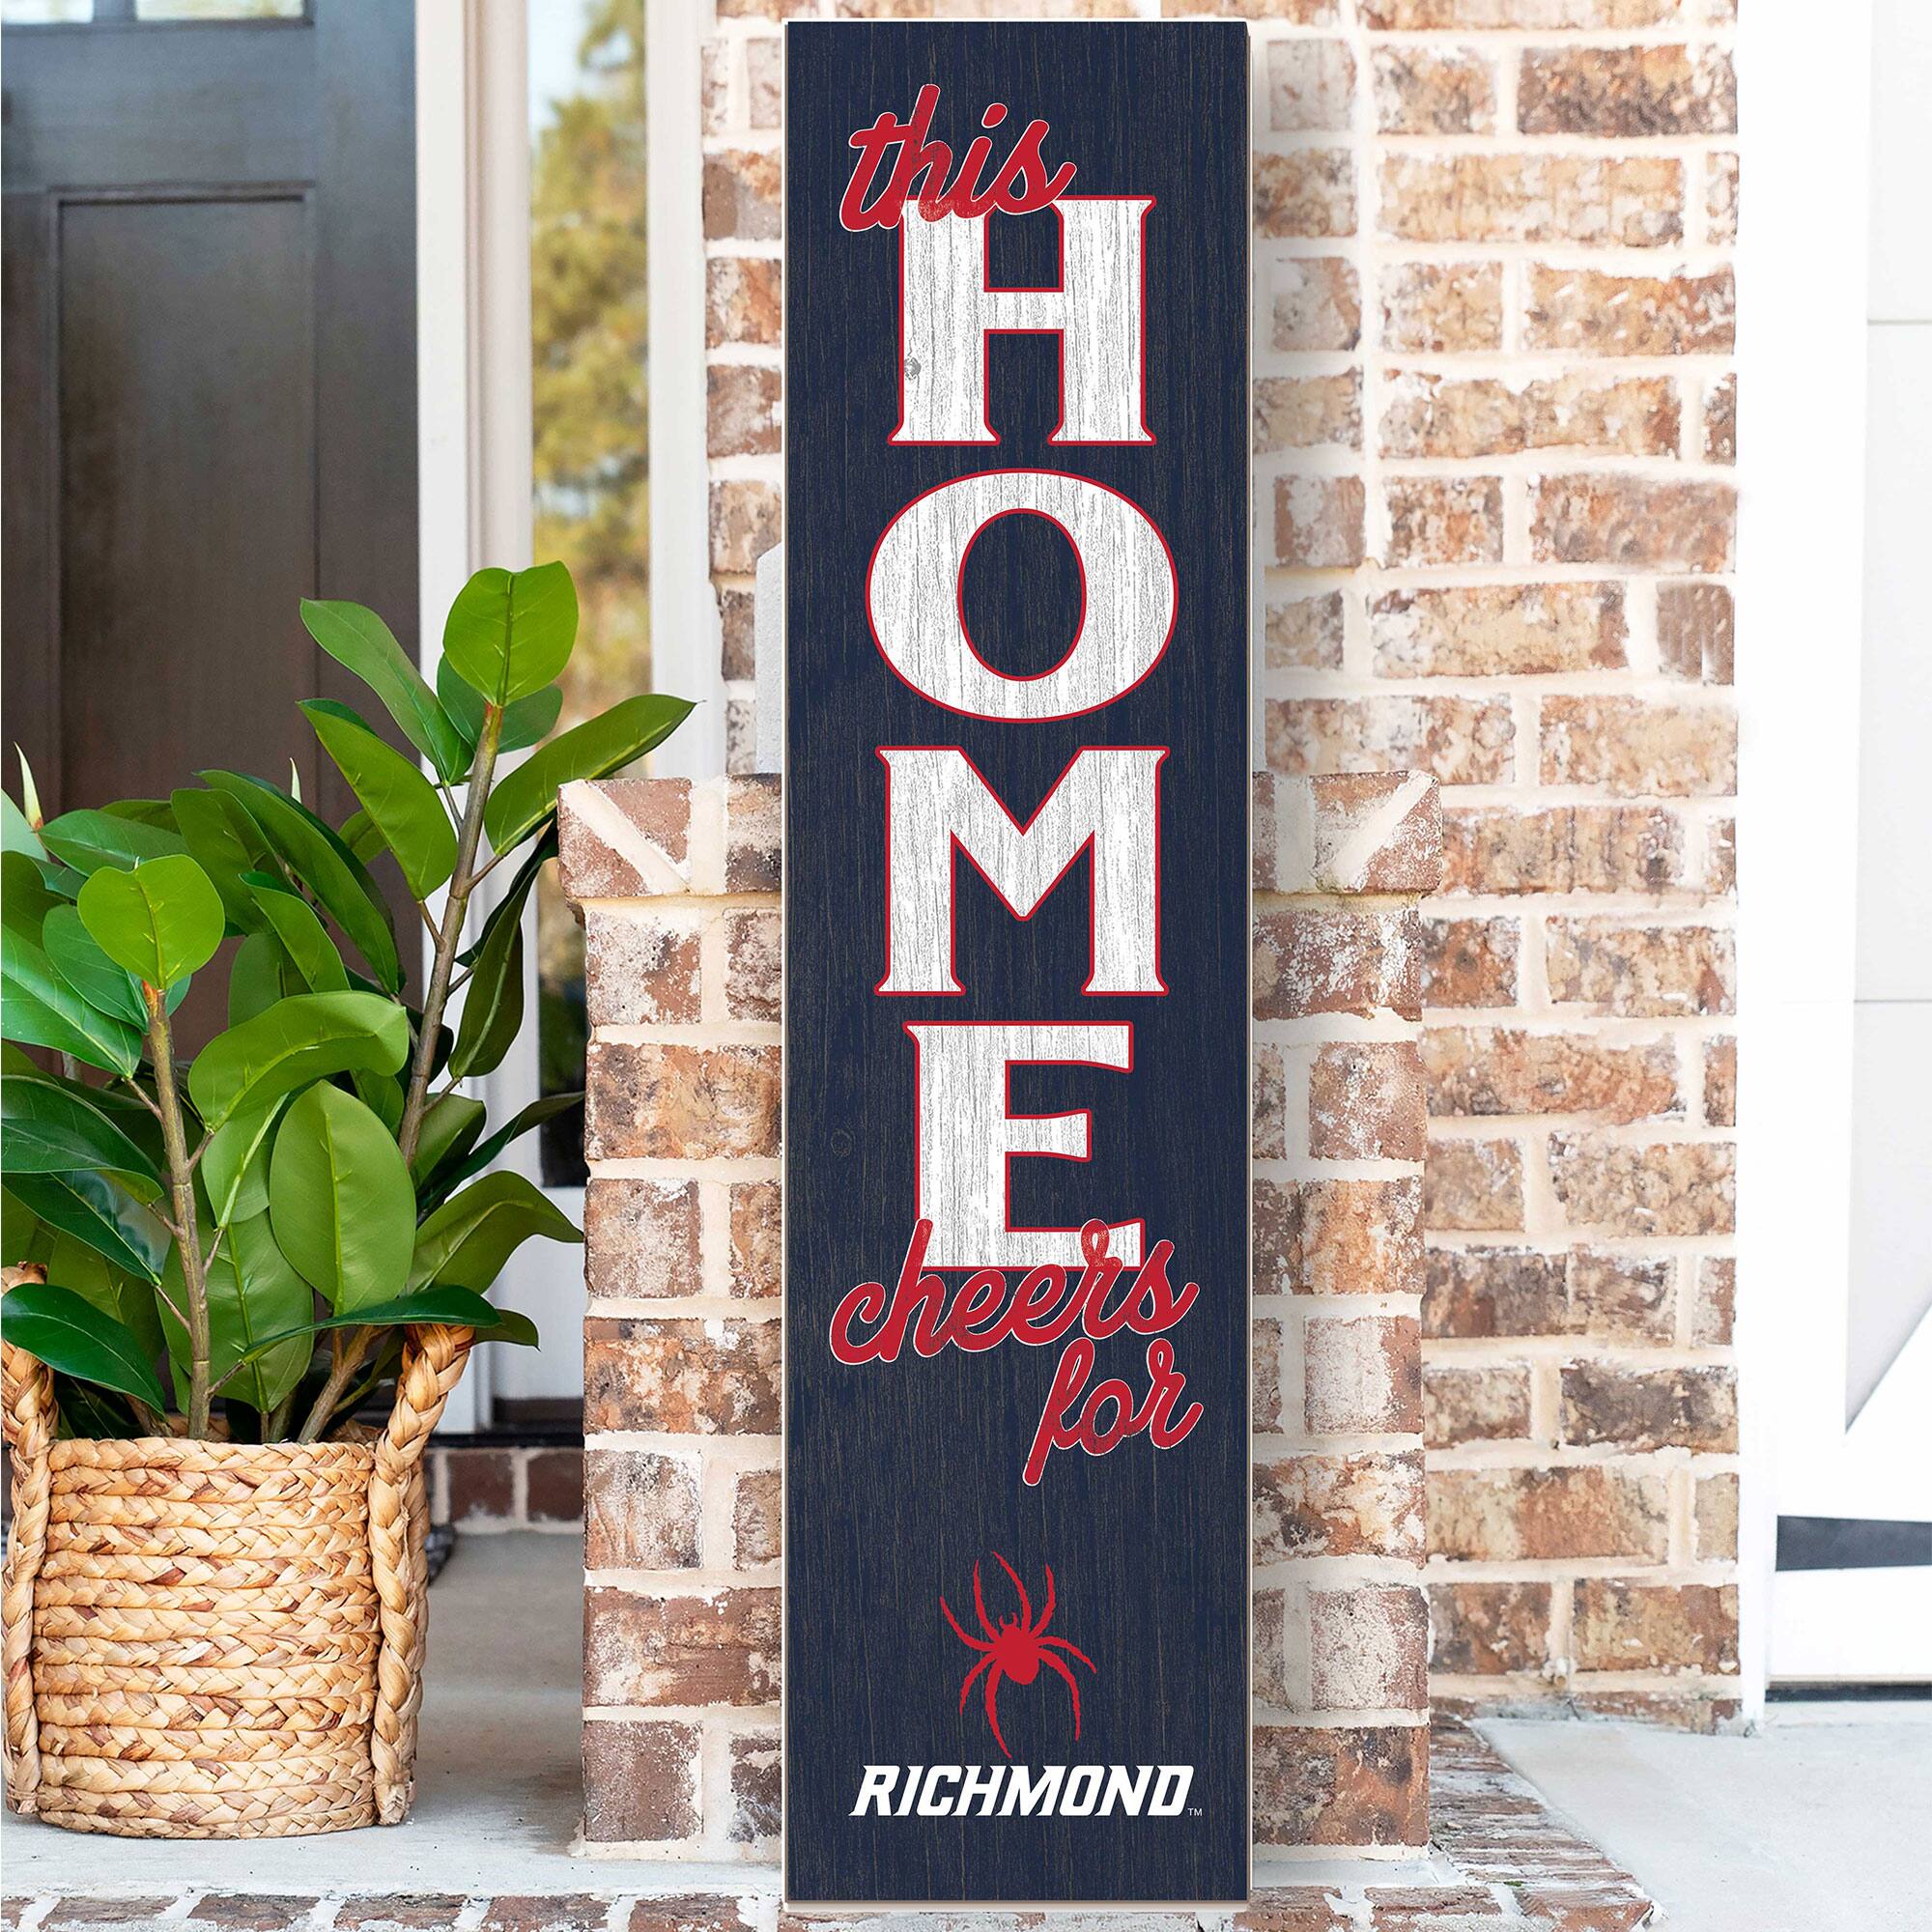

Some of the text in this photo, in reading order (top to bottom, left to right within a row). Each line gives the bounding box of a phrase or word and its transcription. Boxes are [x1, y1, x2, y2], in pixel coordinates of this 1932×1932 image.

[839, 83, 1077, 232] this
[829, 1218, 1201, 1366] cheers
[1022, 1337, 1204, 1487] for
[848, 1765, 1203, 1816] RICHMOND TM
